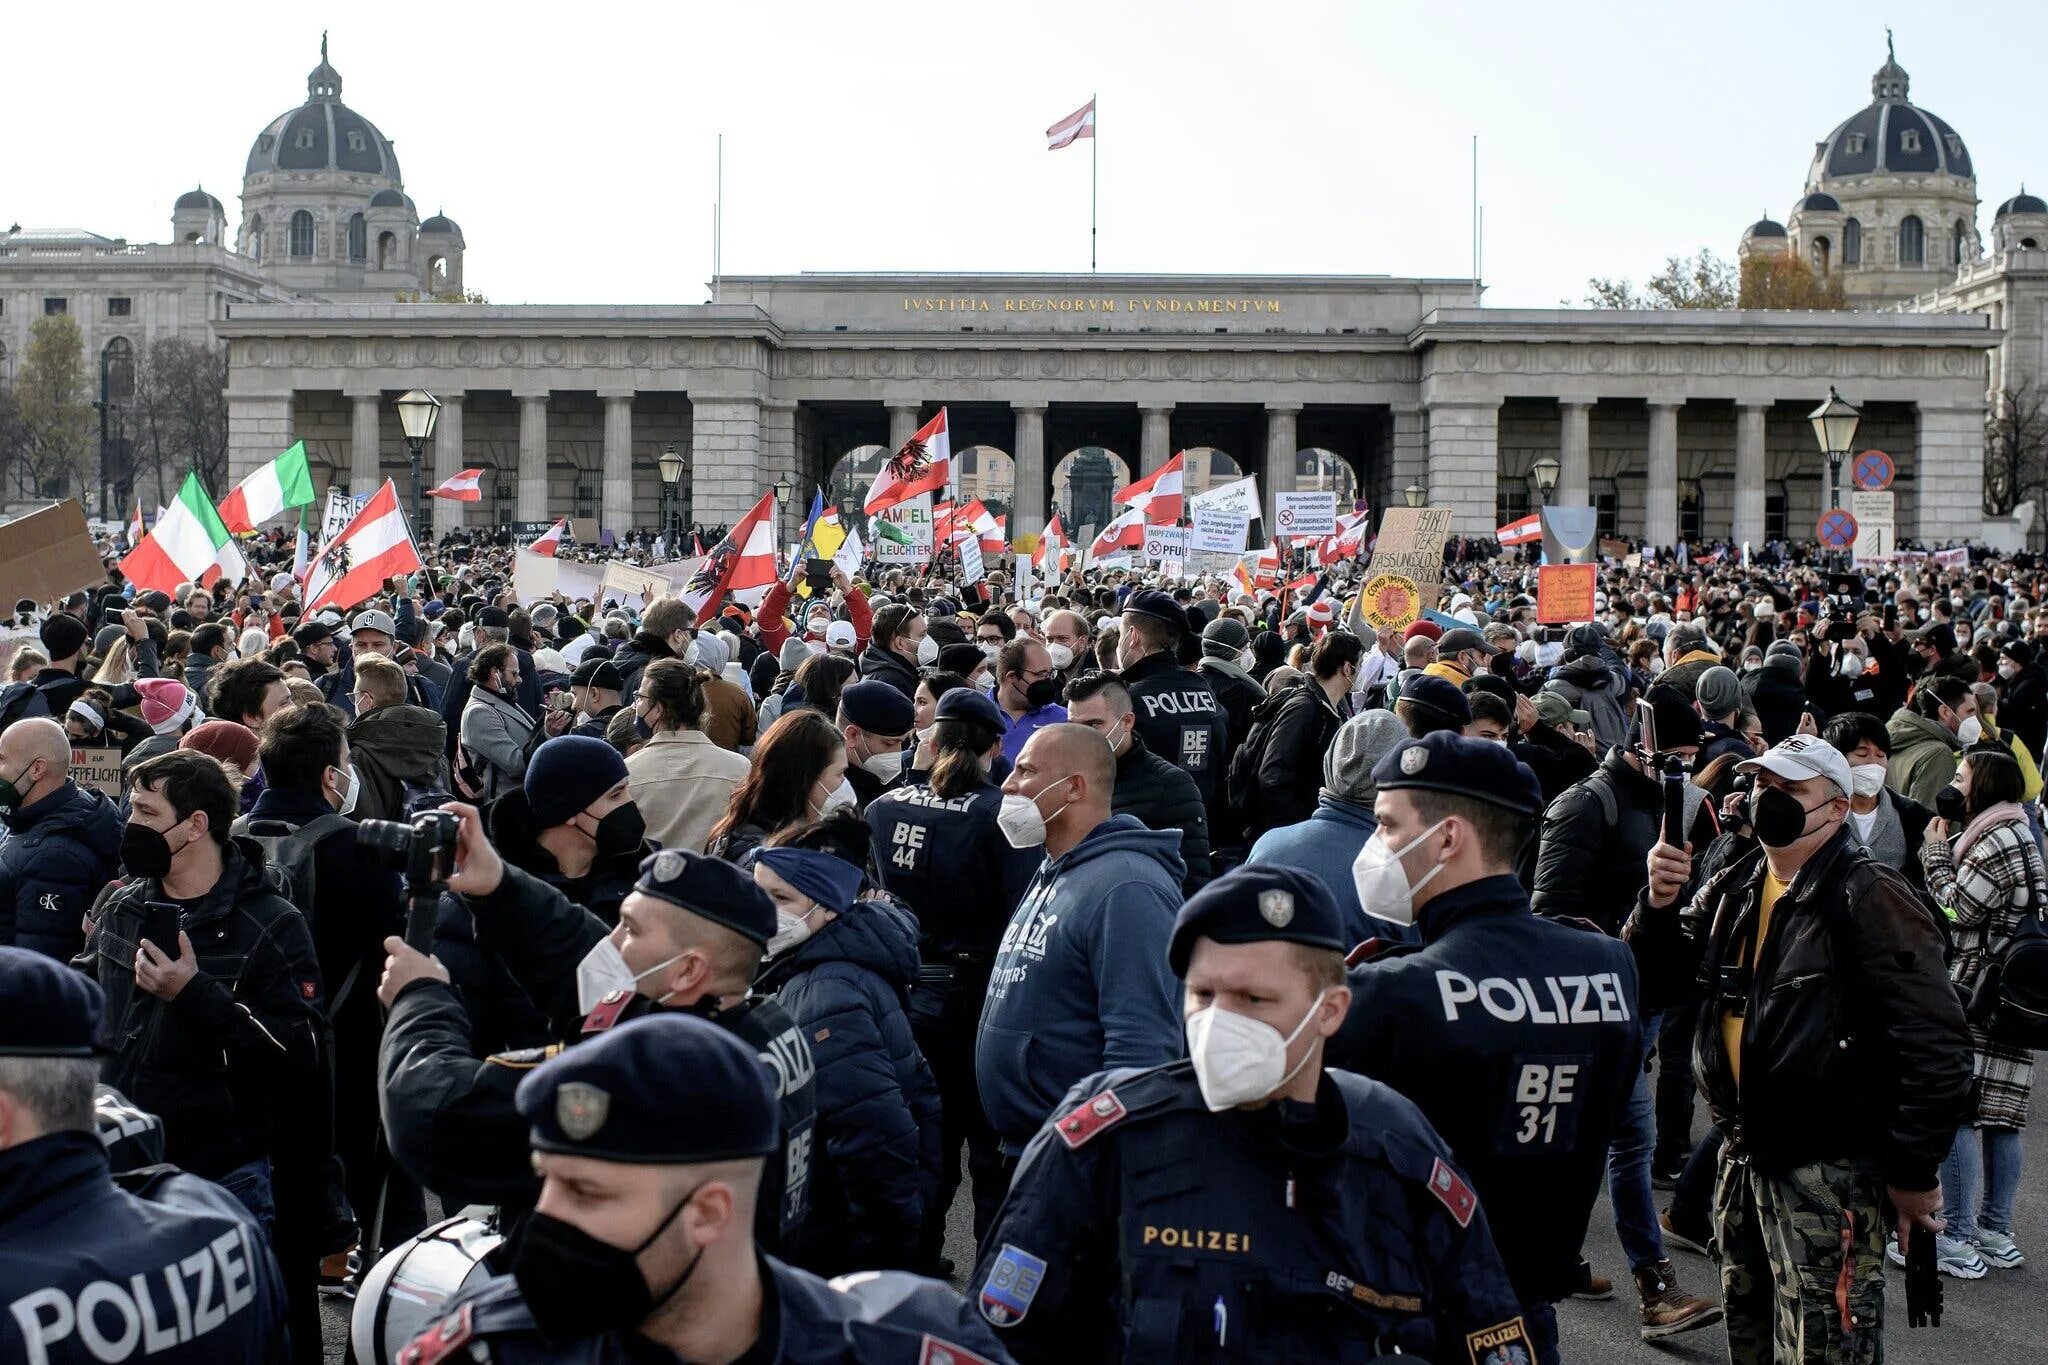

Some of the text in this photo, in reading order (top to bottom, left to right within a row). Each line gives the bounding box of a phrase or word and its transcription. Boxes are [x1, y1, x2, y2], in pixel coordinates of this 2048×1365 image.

[881, 508, 930, 523] AMPEL
[880, 545, 932, 555] LEUCHTER
[1367, 576, 1418, 597] COVID IMPFUNG
[1141, 691, 1217, 718] POLIZEI
[1183, 730, 1208, 751] BE
[1187, 753, 1201, 767] 44
[892, 821, 926, 849] BE
[892, 845, 916, 870] 44
[1435, 969, 1631, 1024] POLIZEI
[1516, 1064, 1580, 1103] BE
[1516, 1105, 1558, 1144] 31
[1143, 1226, 1250, 1252] POLIZEI
[8, 1221, 256, 1365] POLIZEI
[993, 1259, 1040, 1301] BE
[1473, 1323, 1521, 1352] POLIZEI
